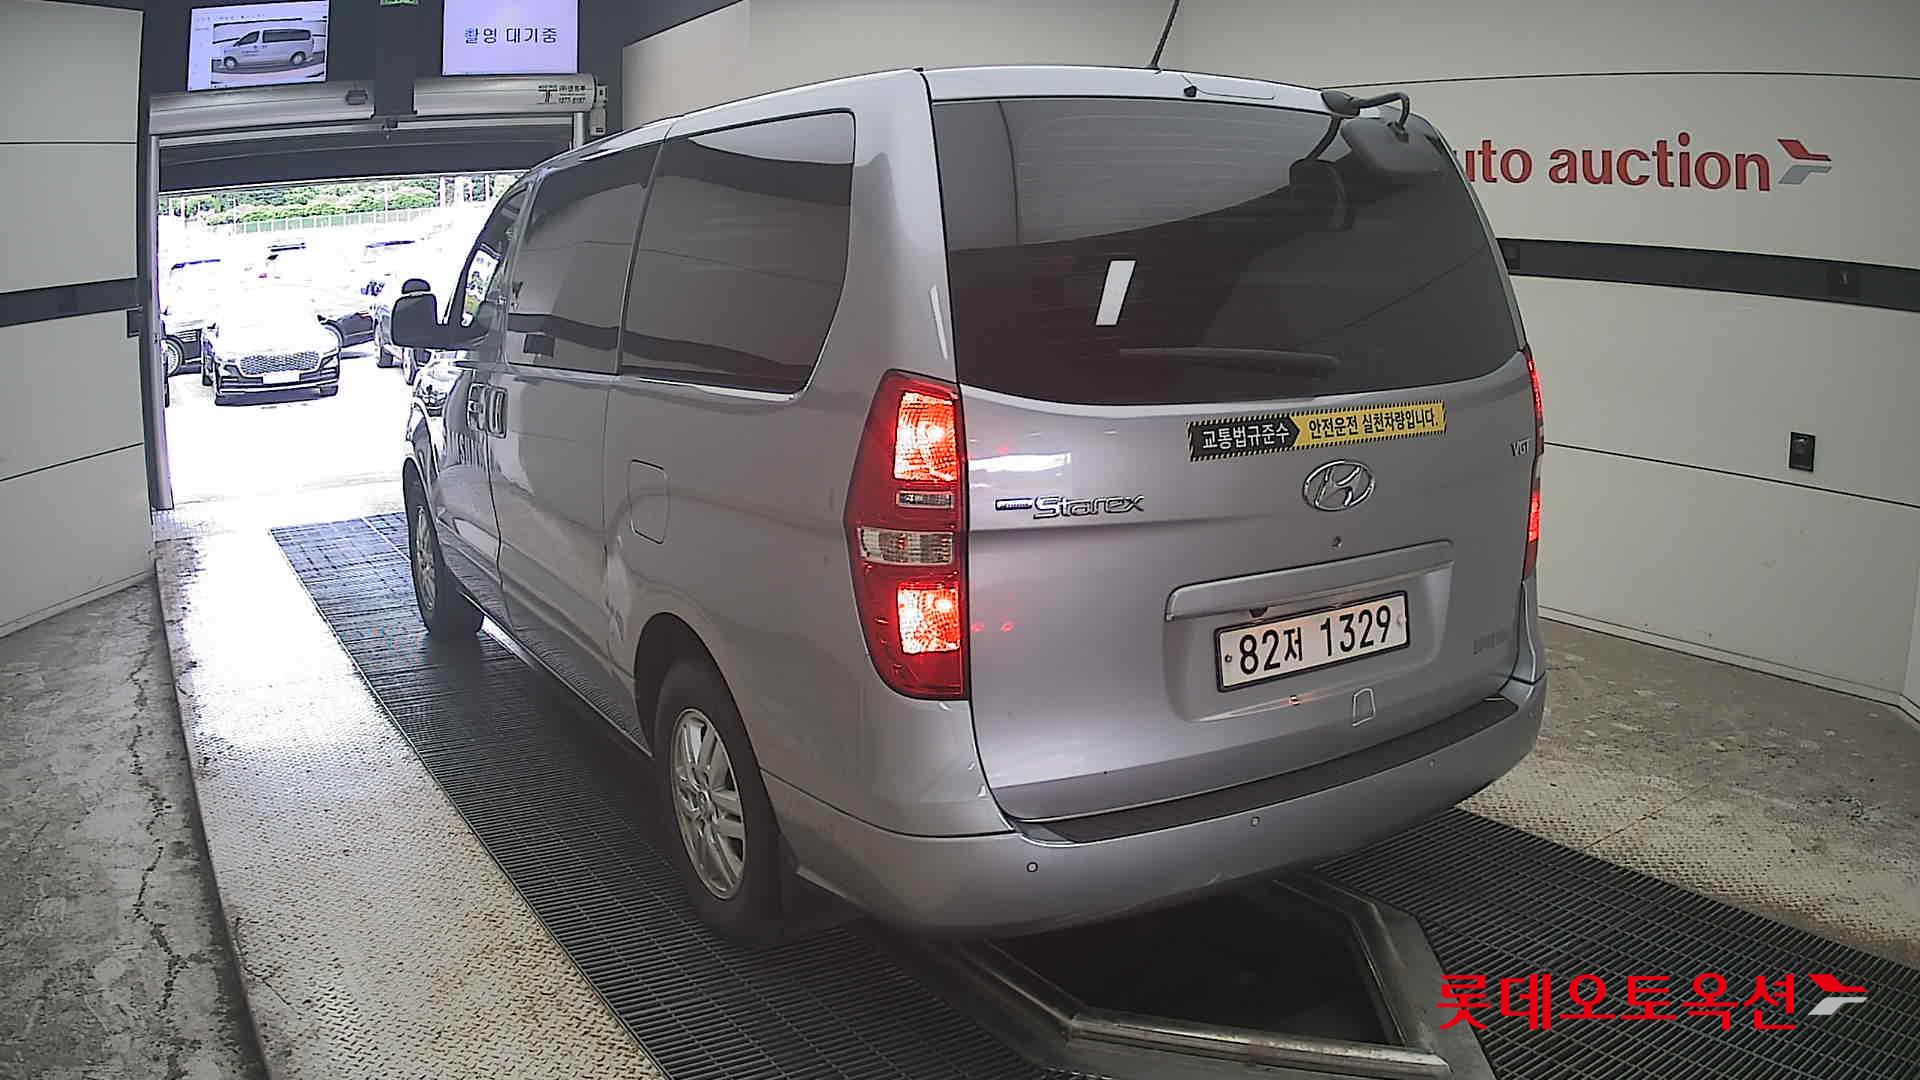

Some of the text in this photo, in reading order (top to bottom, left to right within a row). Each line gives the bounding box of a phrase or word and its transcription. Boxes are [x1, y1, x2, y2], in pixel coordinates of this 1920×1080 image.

[506, 28, 557, 44] 대기중
[1548, 132, 1771, 192] auction
[1202, 423, 1290, 449] 교통법규준수
[1308, 418, 1359, 439] 안전운전
[1033, 496, 1144, 519] Starex
[1239, 605, 1392, 675] 82저 1329
